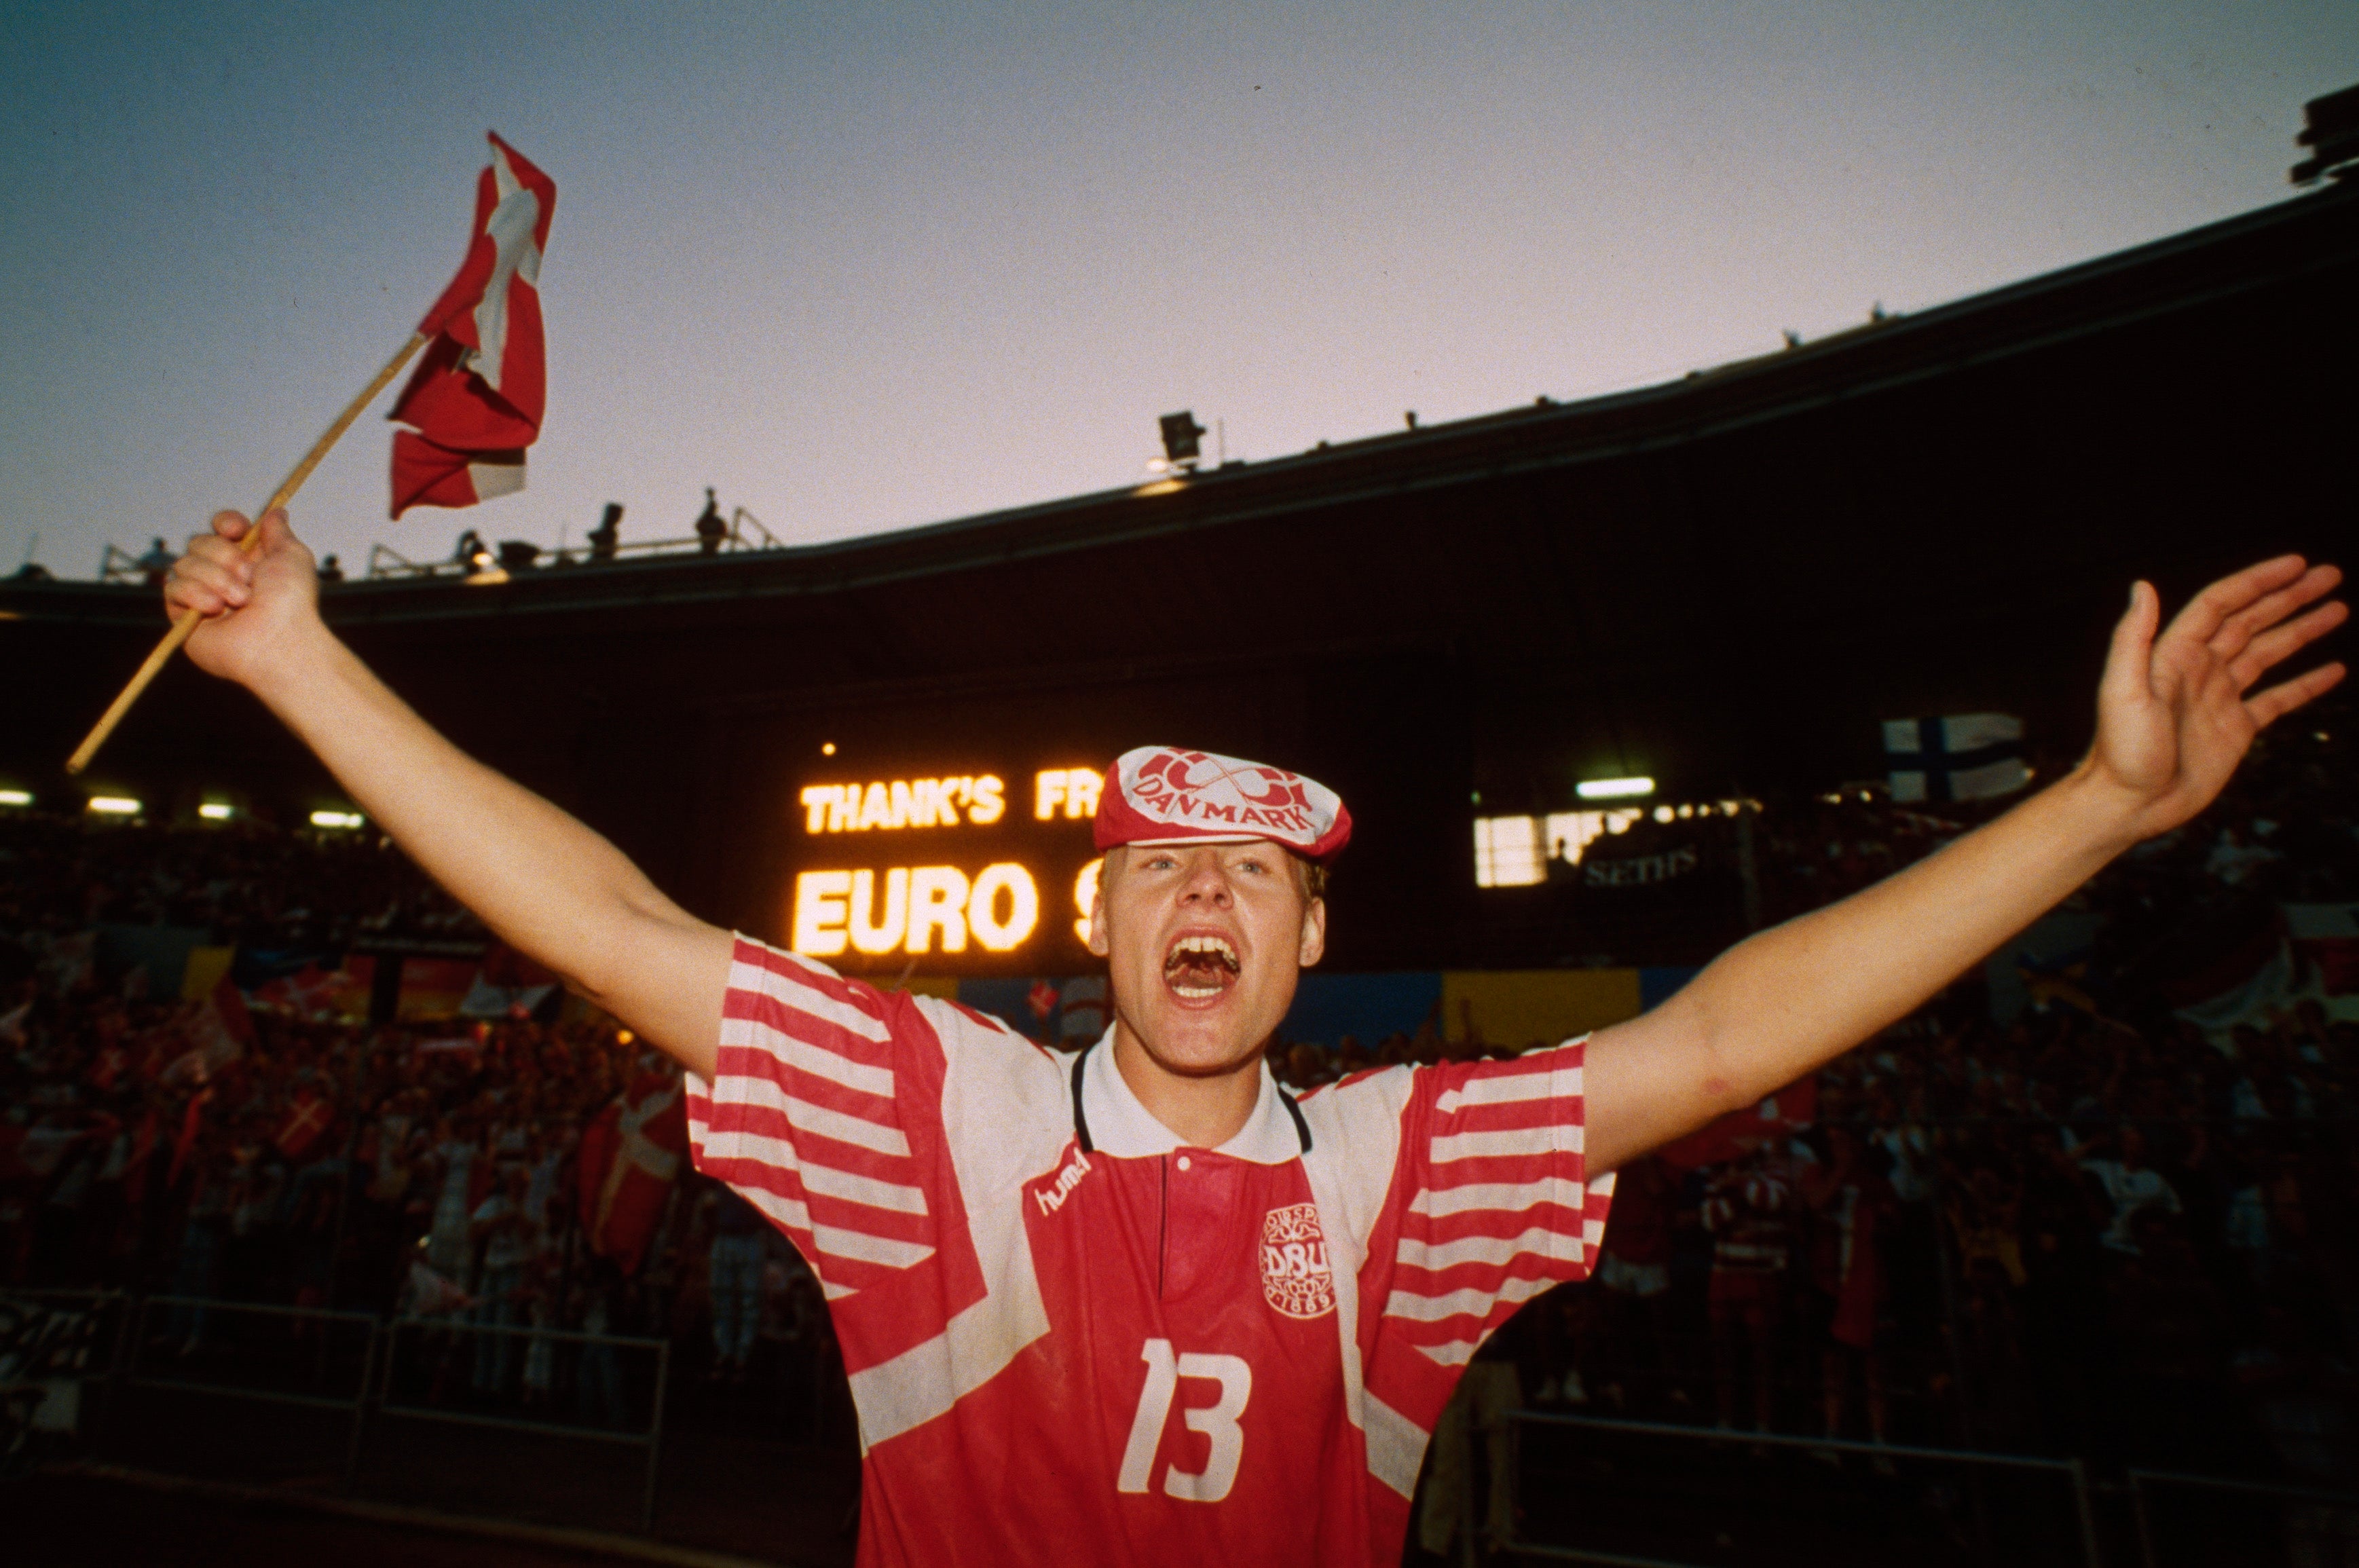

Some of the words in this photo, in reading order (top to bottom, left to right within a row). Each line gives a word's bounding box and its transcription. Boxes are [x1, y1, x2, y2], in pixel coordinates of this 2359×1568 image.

[801, 775, 1005, 833] THANK'S
[1036, 768, 1105, 819] FR
[1133, 777, 1316, 832] DANMARK
[792, 863, 1039, 954] EURO
[1264, 1242, 1331, 1277] DBU
[1117, 1338, 1252, 1503] 13
